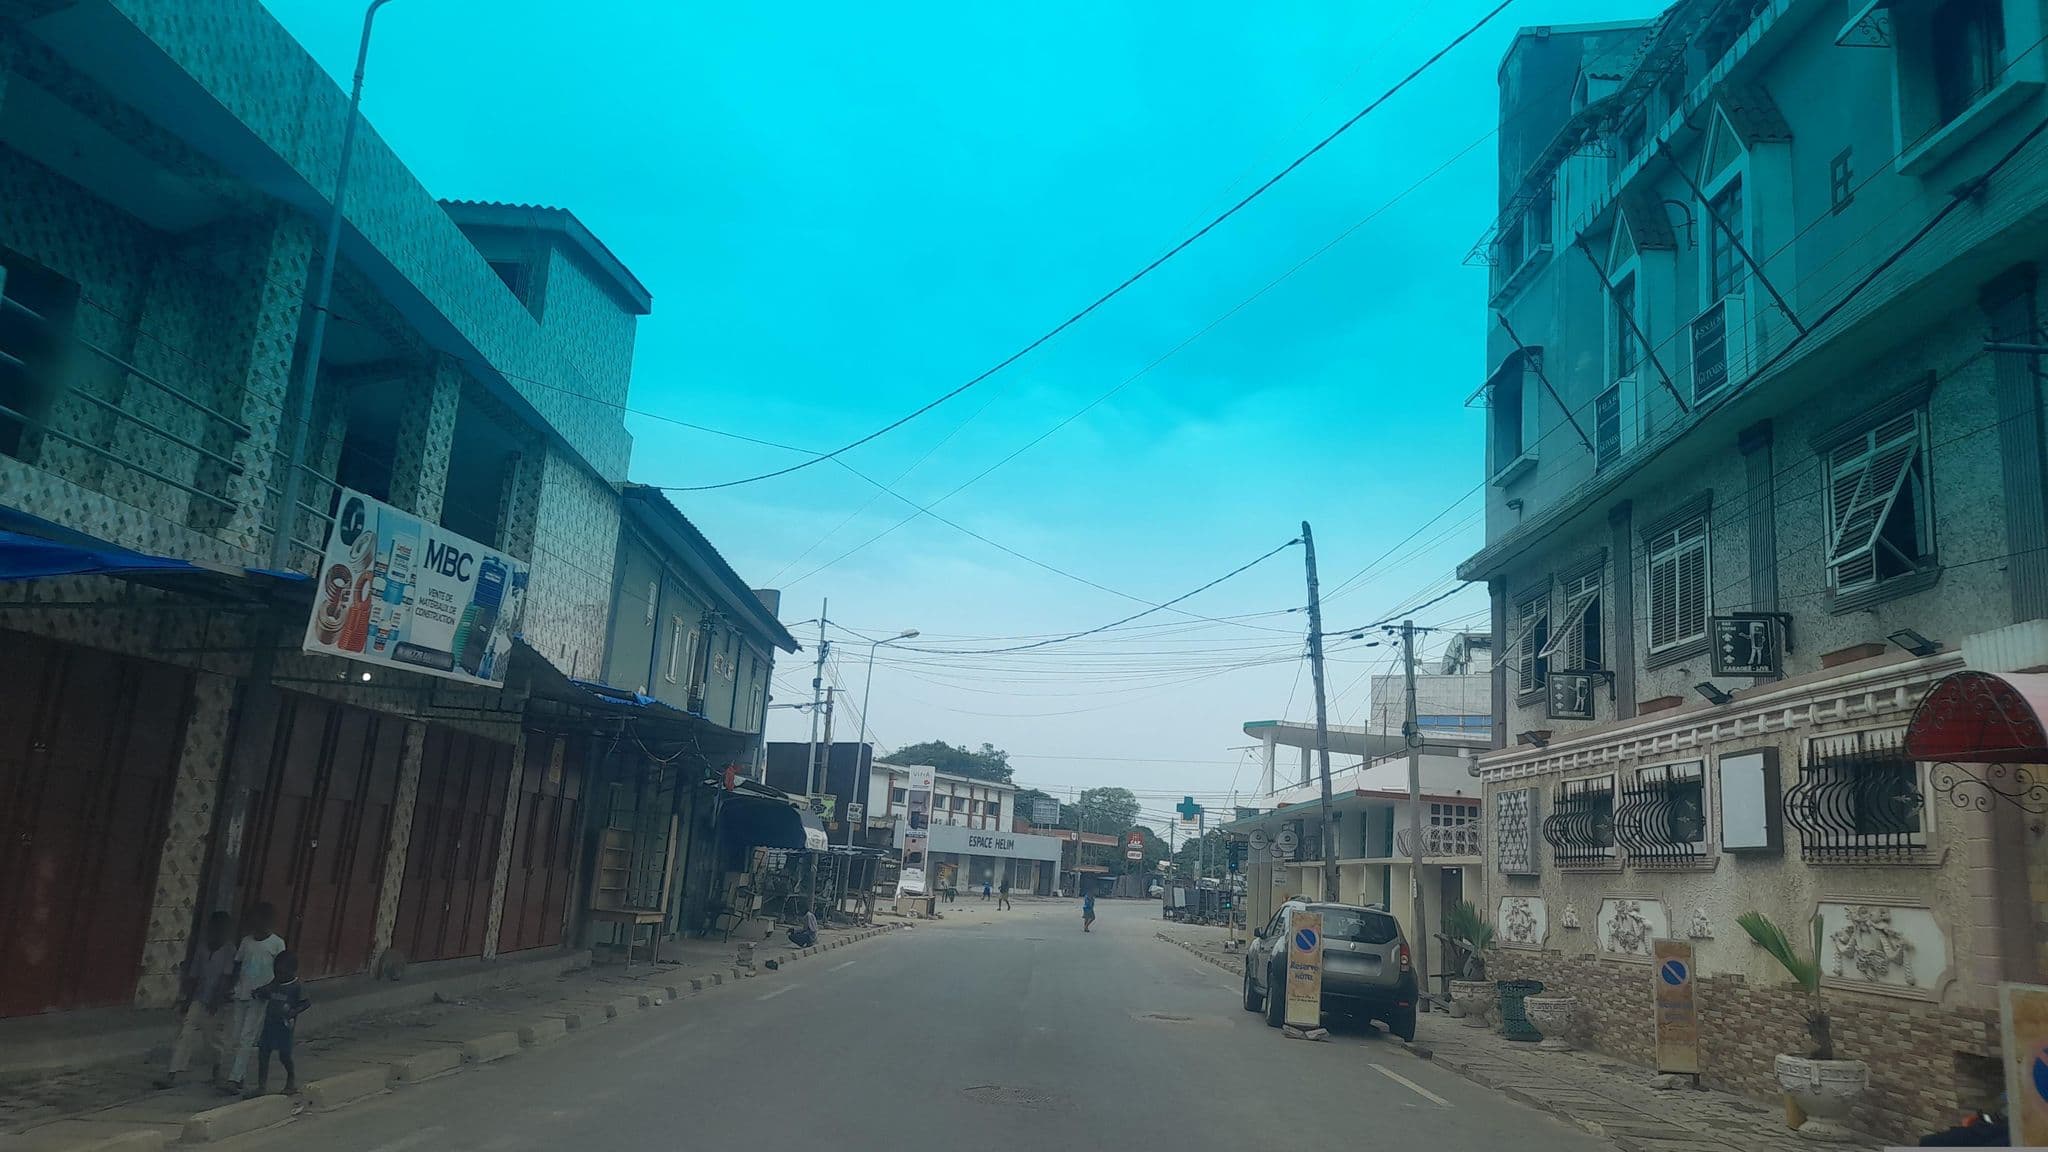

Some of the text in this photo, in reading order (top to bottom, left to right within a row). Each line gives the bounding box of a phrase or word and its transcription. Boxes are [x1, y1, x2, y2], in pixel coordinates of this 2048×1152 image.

[423, 538, 474, 582] MBC
[428, 587, 454, 603] VENTE DE
[415, 607, 456, 626] CONSTRUCTION
[969, 835, 1015, 850] ESPACE HELIM
